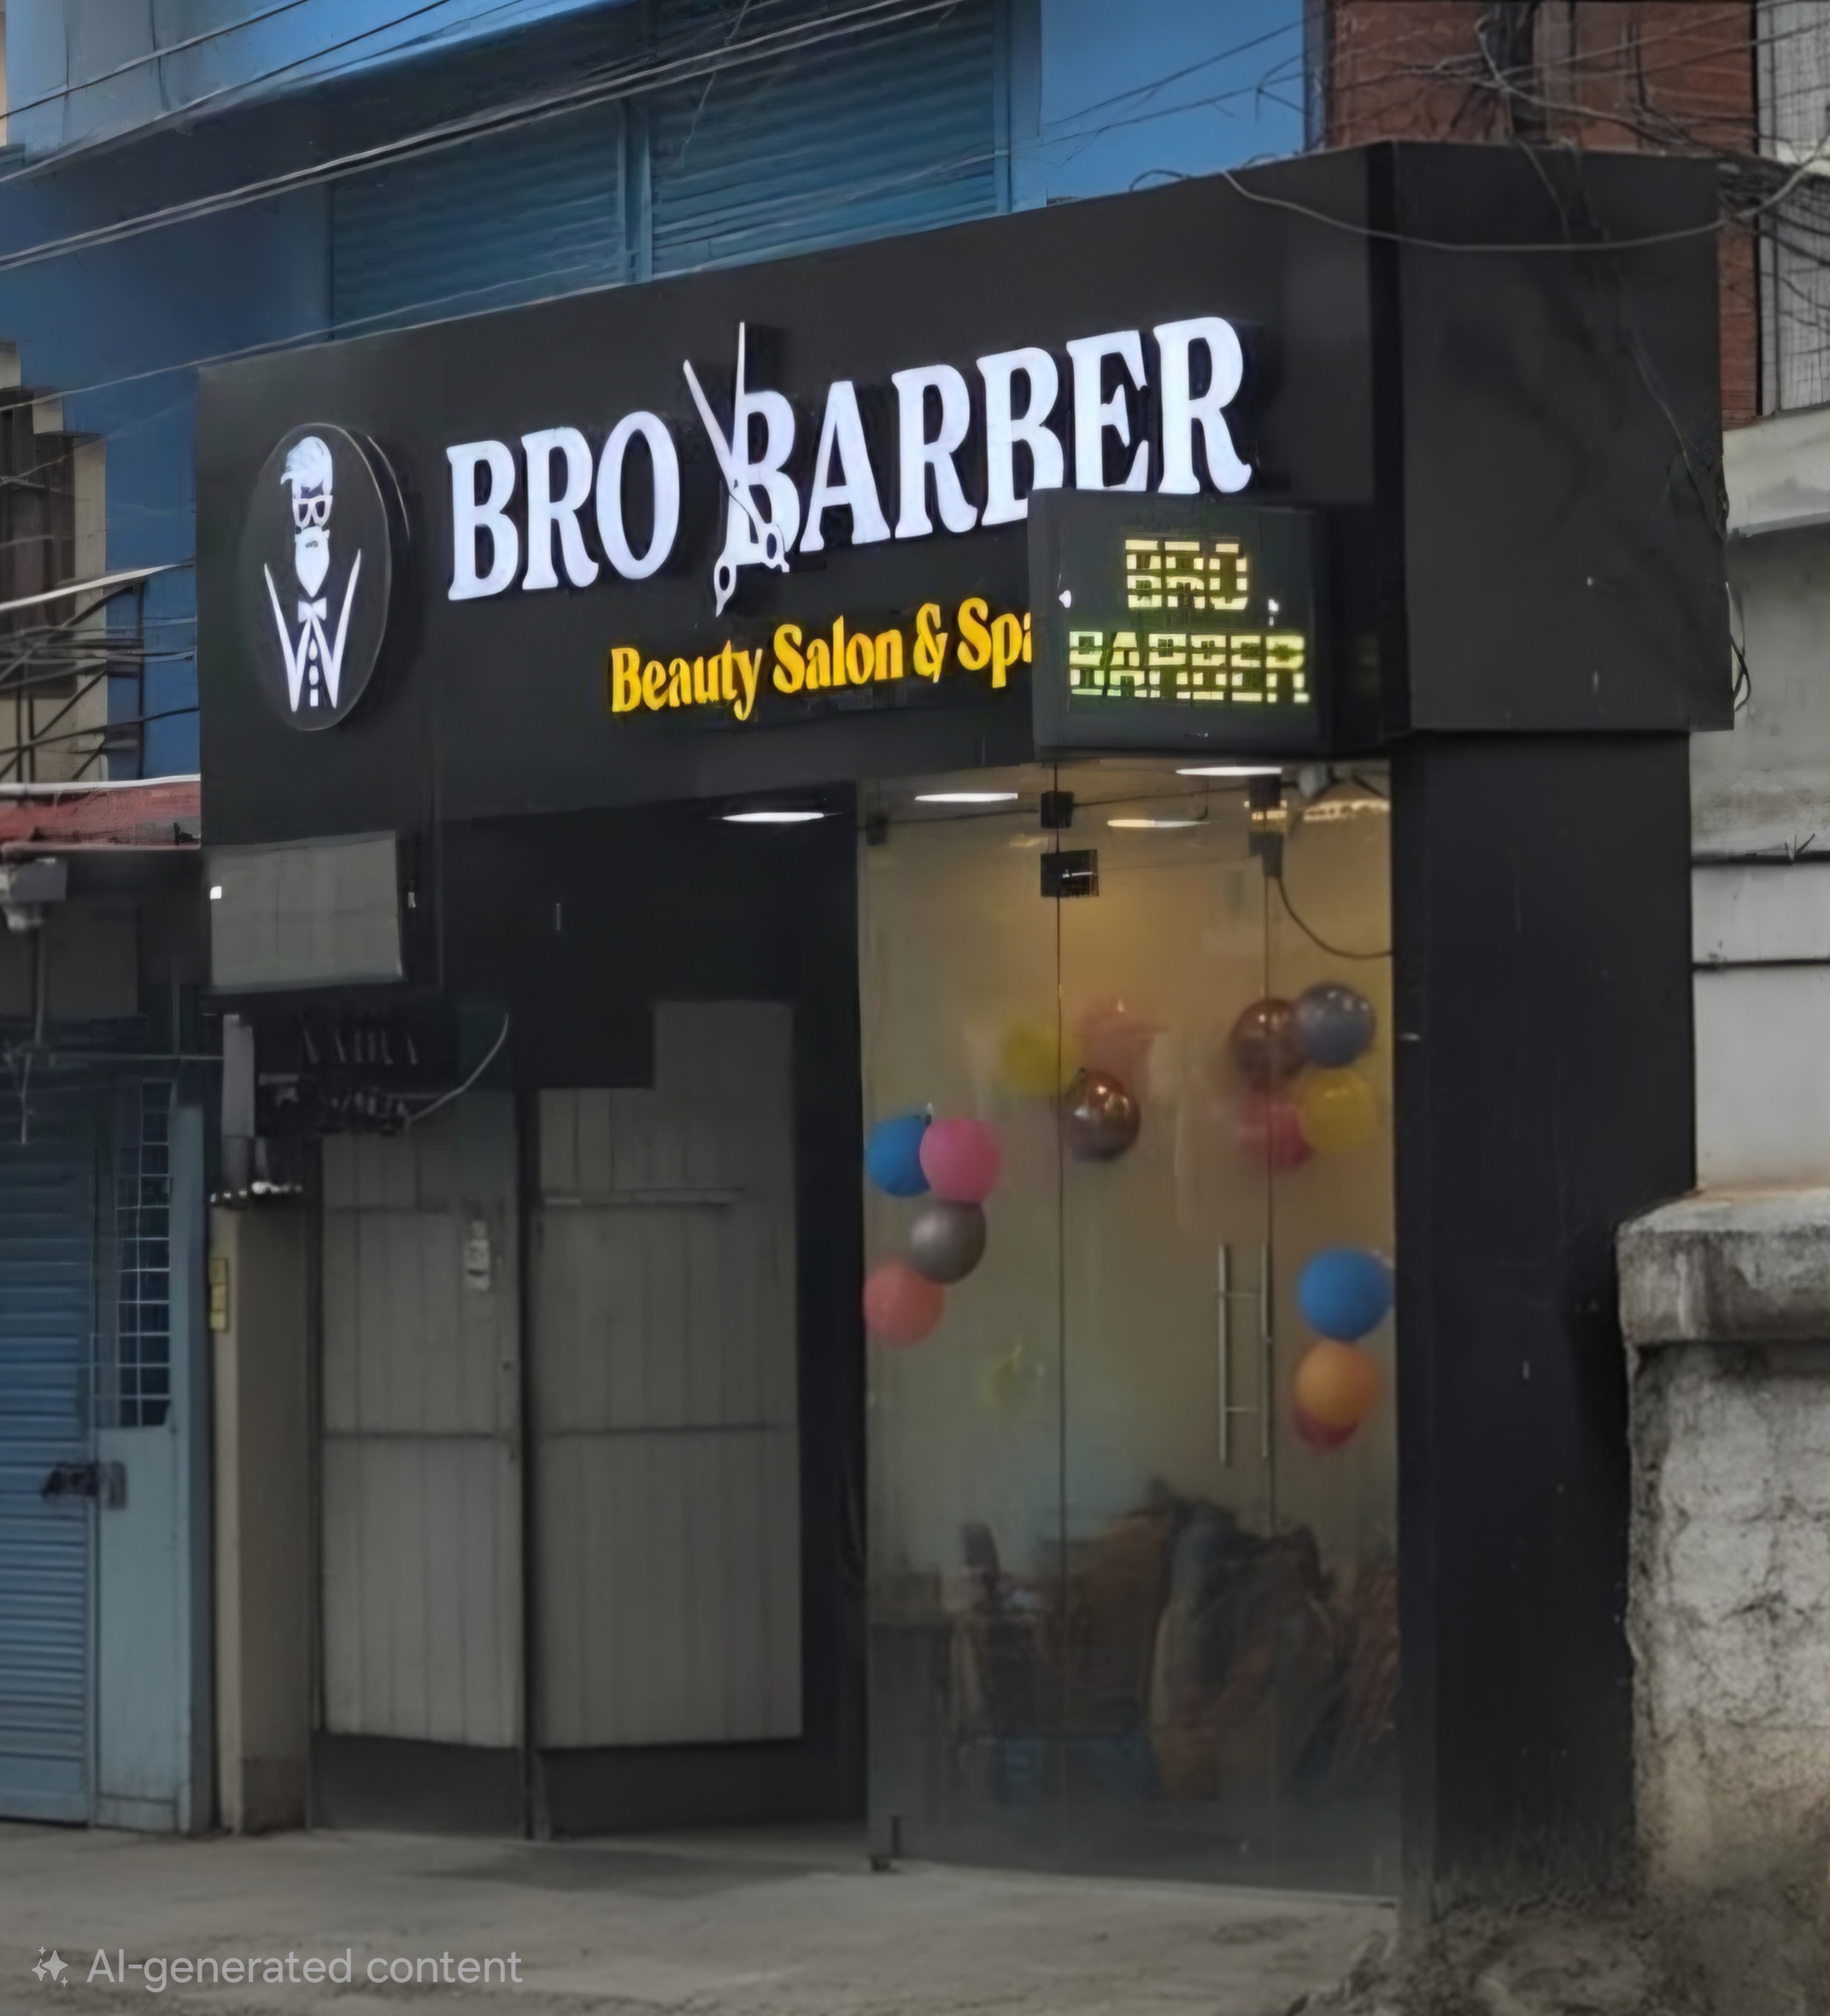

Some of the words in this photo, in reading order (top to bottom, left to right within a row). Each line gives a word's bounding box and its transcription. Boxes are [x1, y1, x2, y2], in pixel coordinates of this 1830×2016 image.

[446, 411, 682, 602] BRO
[723, 316, 1253, 573] BARBER
[1124, 539, 1248, 611] BRO
[611, 639, 764, 721] Beauty
[773, 614, 904, 694] Salon
[912, 602, 947, 683] &
[1069, 630, 1310, 704] BARBER
